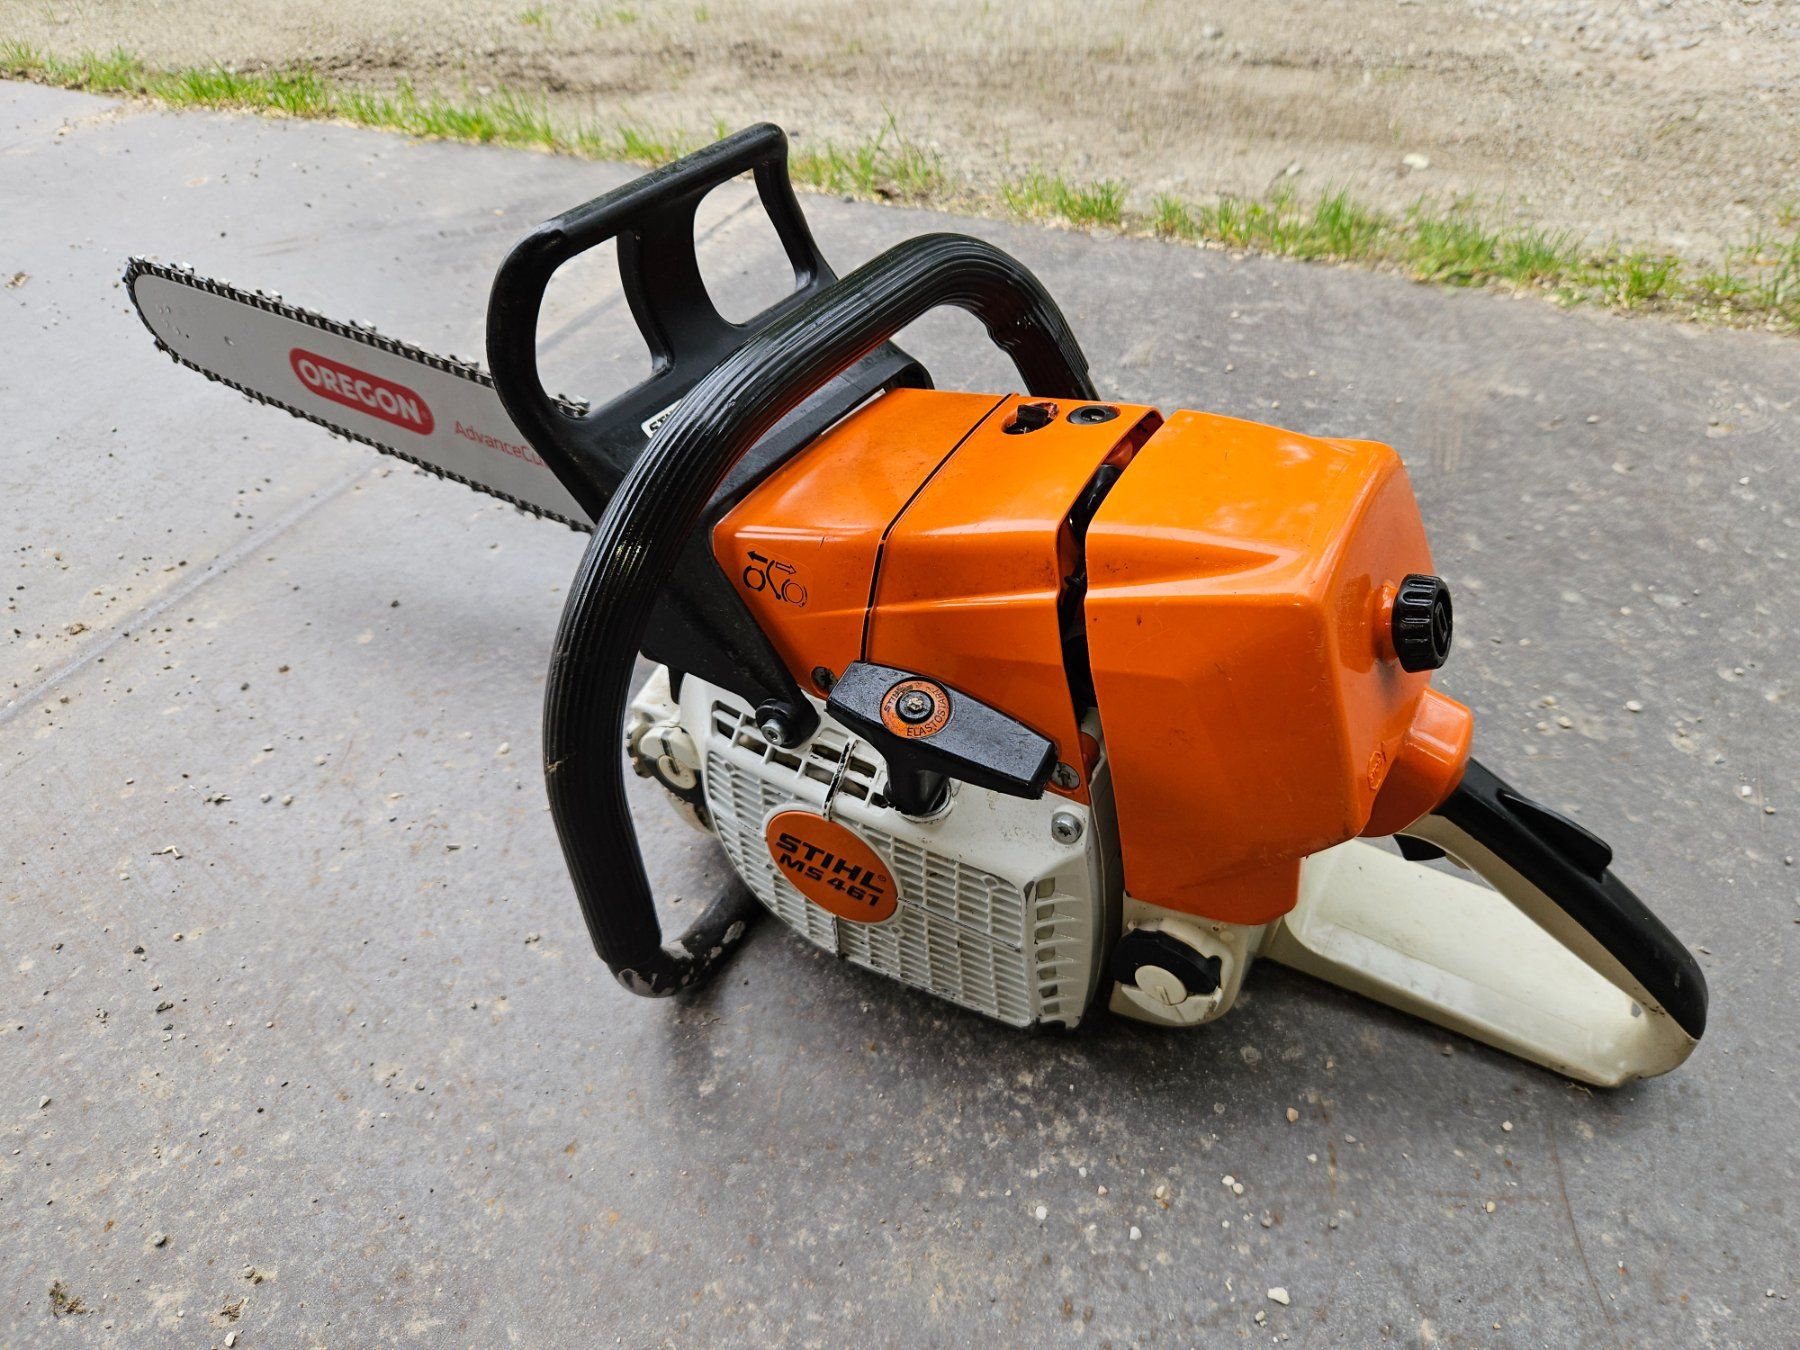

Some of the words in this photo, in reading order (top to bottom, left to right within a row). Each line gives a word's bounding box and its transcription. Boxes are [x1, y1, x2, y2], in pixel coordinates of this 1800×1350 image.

[298, 359, 424, 425] OREGON
[455, 420, 550, 468] AdvanceCu
[775, 832, 885, 894] STIHL
[779, 853, 825, 881] MS
[827, 877, 880, 907] 461
